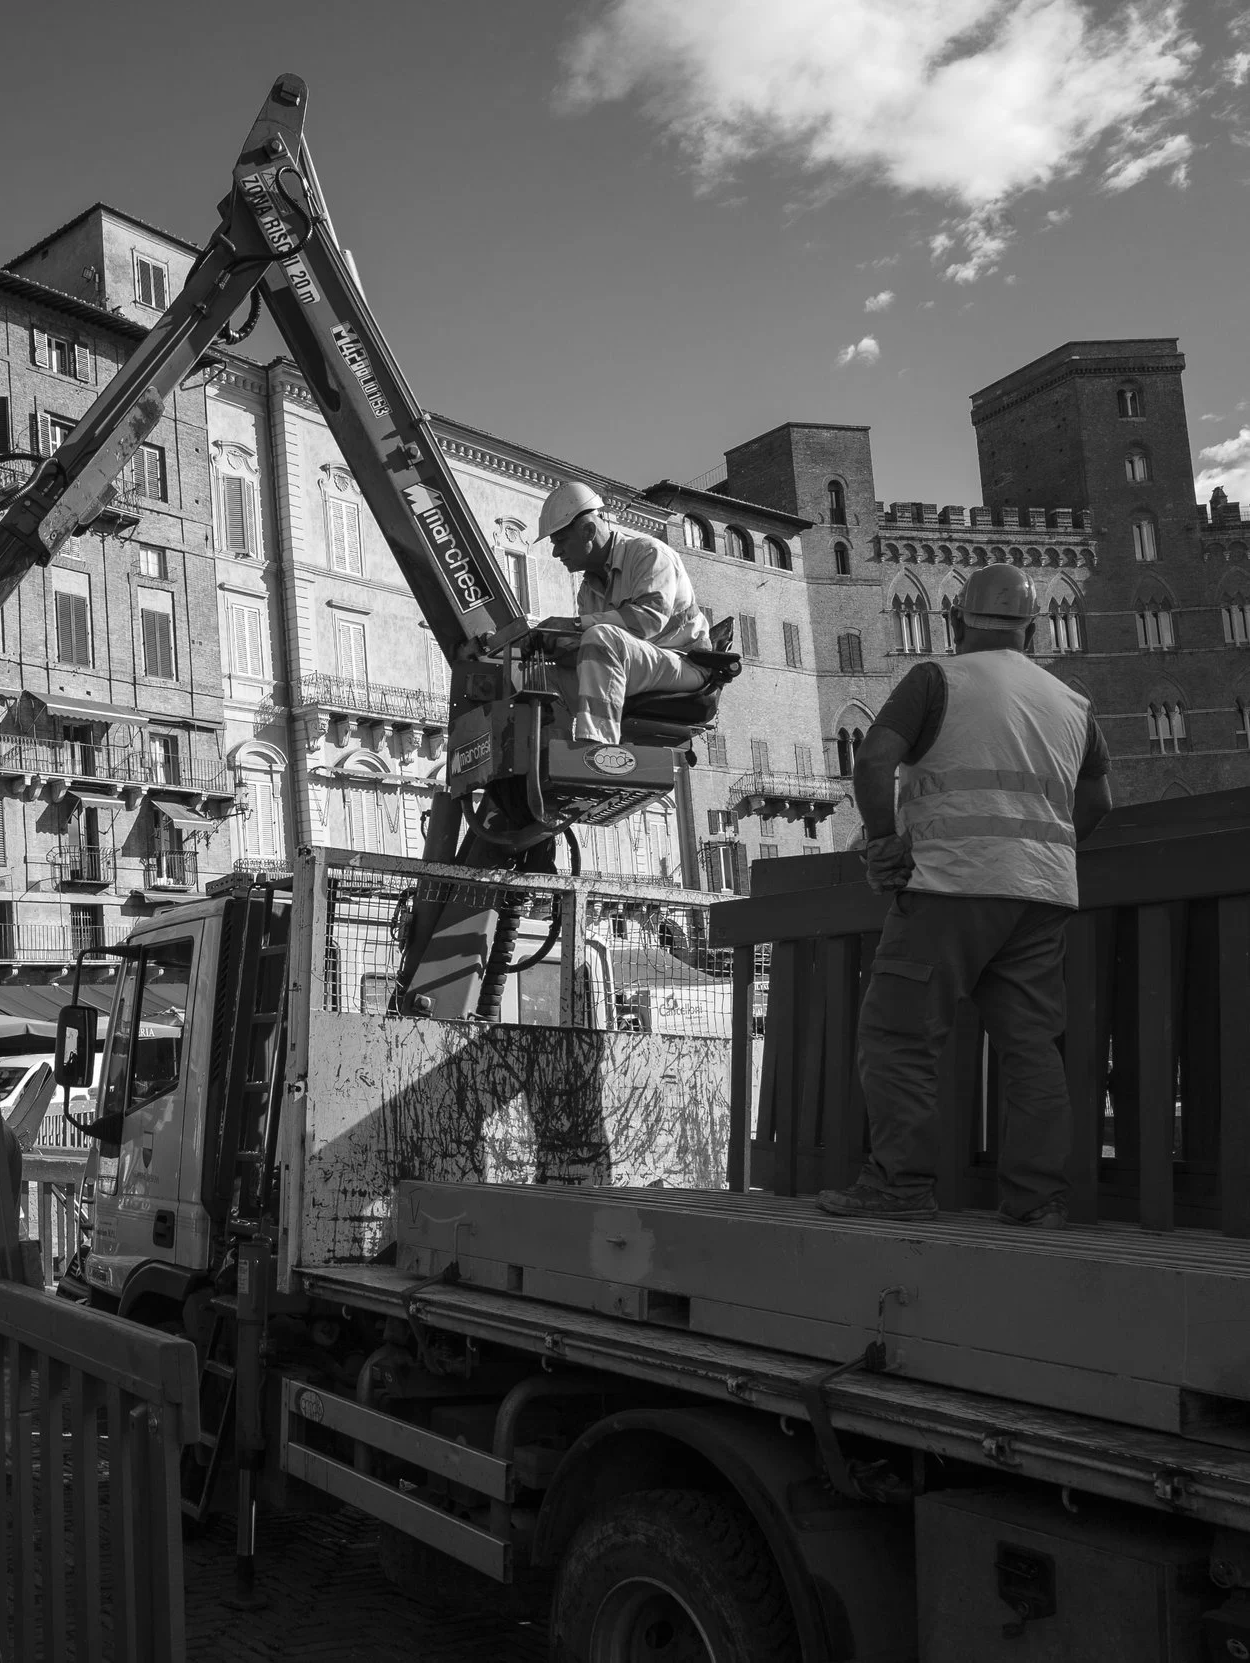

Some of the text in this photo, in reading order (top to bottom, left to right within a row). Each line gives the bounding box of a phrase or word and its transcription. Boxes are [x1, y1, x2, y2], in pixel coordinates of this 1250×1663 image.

[241, 175, 274, 217] ZONA
[290, 270, 311, 290] 20
[299, 290, 316, 305] m
[423, 508, 490, 607] marchesi
